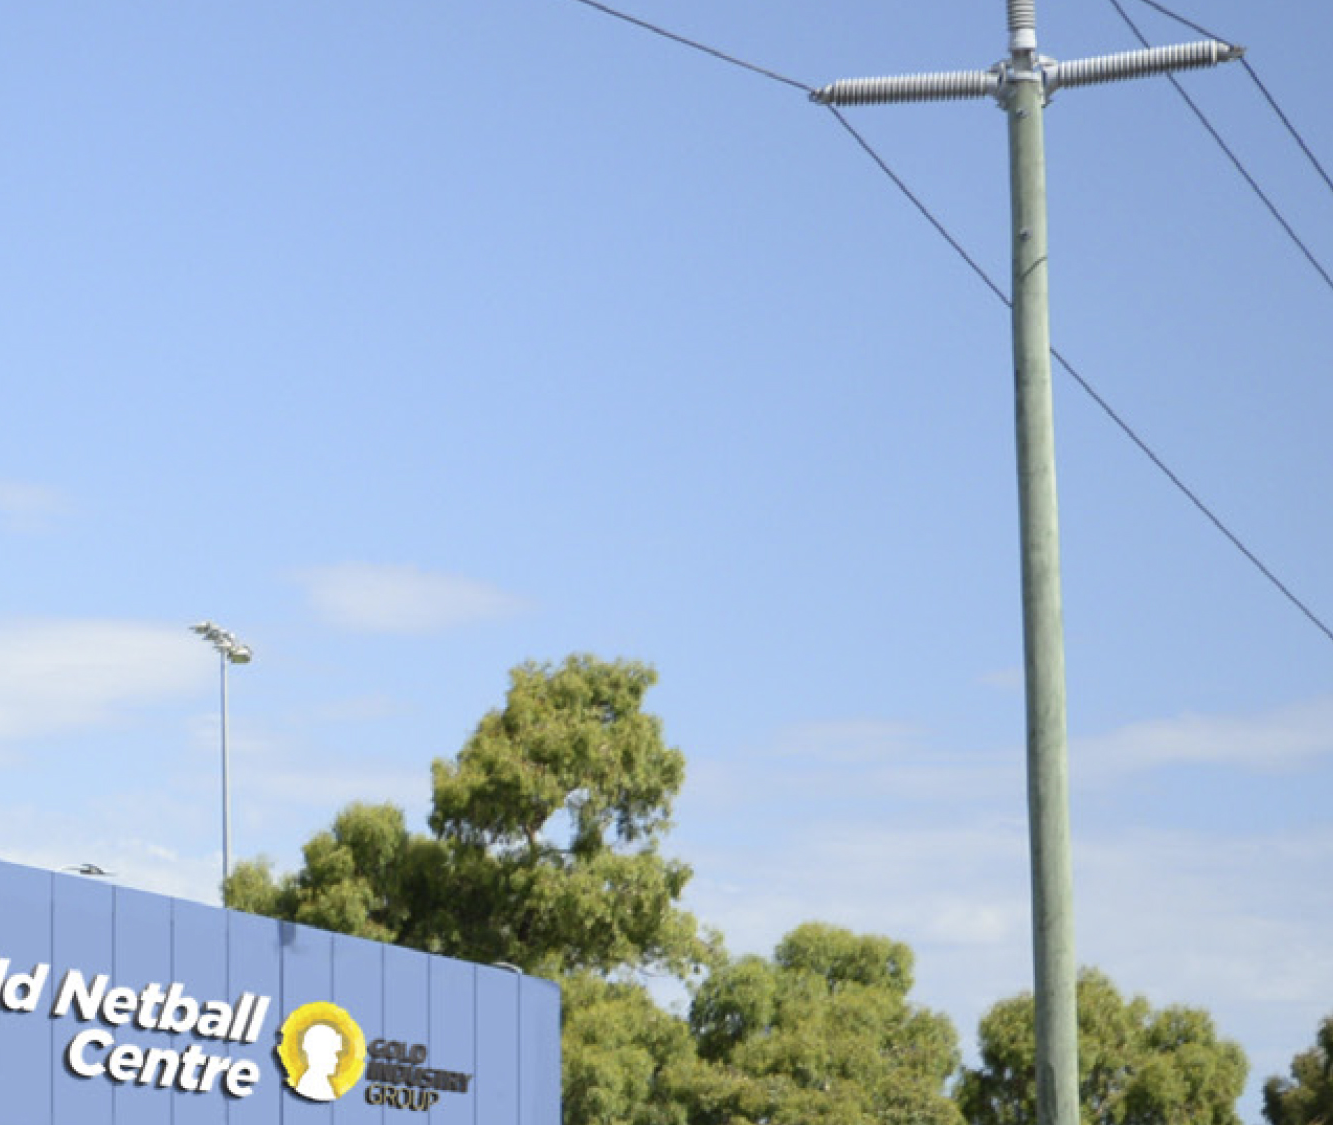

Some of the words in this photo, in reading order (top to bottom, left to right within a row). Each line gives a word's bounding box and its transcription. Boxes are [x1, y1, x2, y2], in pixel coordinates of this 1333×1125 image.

[51, 969, 271, 1042] Netball
[65, 1029, 260, 1098] Centre
[368, 1038, 426, 1064] GOLD
[366, 1061, 472, 1092] INDUSTRY
[364, 1083, 439, 1111] GROUP
